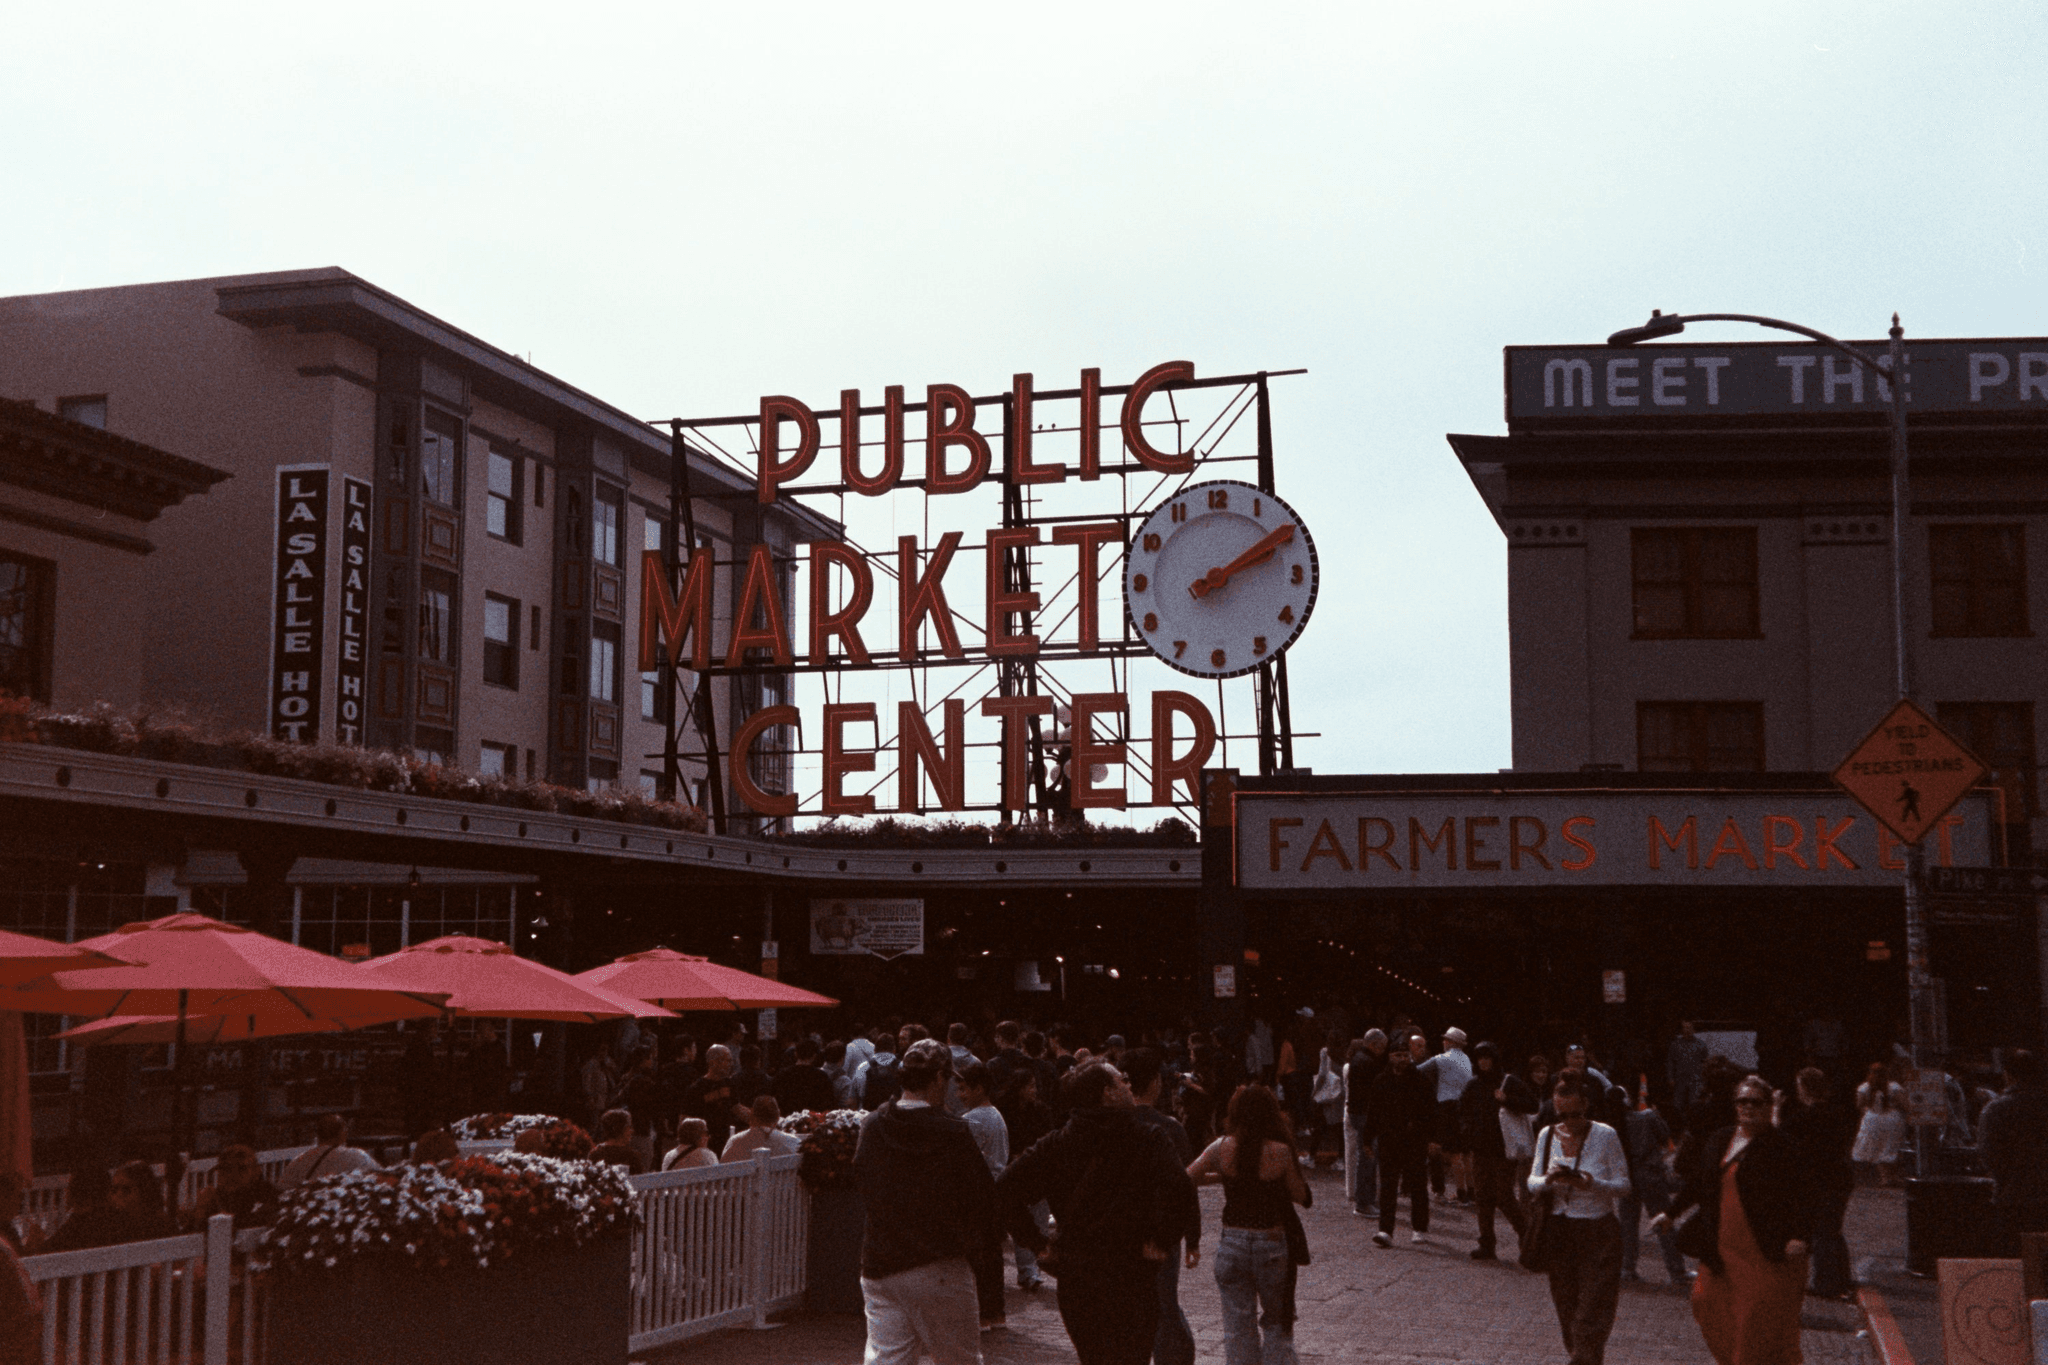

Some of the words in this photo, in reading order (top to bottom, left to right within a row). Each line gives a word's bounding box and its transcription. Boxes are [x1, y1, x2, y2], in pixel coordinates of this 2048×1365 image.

[1544, 356, 1731, 407] MEET
[1777, 353, 1911, 403] THE
[1969, 352, 2048, 401] PR
[758, 361, 1196, 502] PUBLIC
[286, 478, 317, 523] LA
[348, 484, 366, 533] LA
[1208, 489, 1228, 509] 12
[1254, 498, 1260, 517] 1
[1171, 502, 1186, 523] 11
[1143, 533, 1162, 552] 10
[1134, 573, 1148, 592] 9
[1291, 564, 1303, 585] 3
[284, 532, 317, 653] SALLE
[638, 522, 1123, 672] MARKET
[344, 545, 364, 662] SALLE
[1143, 612, 1158, 632] 8
[1278, 605, 1294, 625] 4
[1173, 640, 1187, 659] 7
[1253, 636, 1266, 655] 5
[1211, 649, 1226, 668] 6
[728, 690, 1216, 815] CENTER
[1269, 815, 1597, 872] FARMERS
